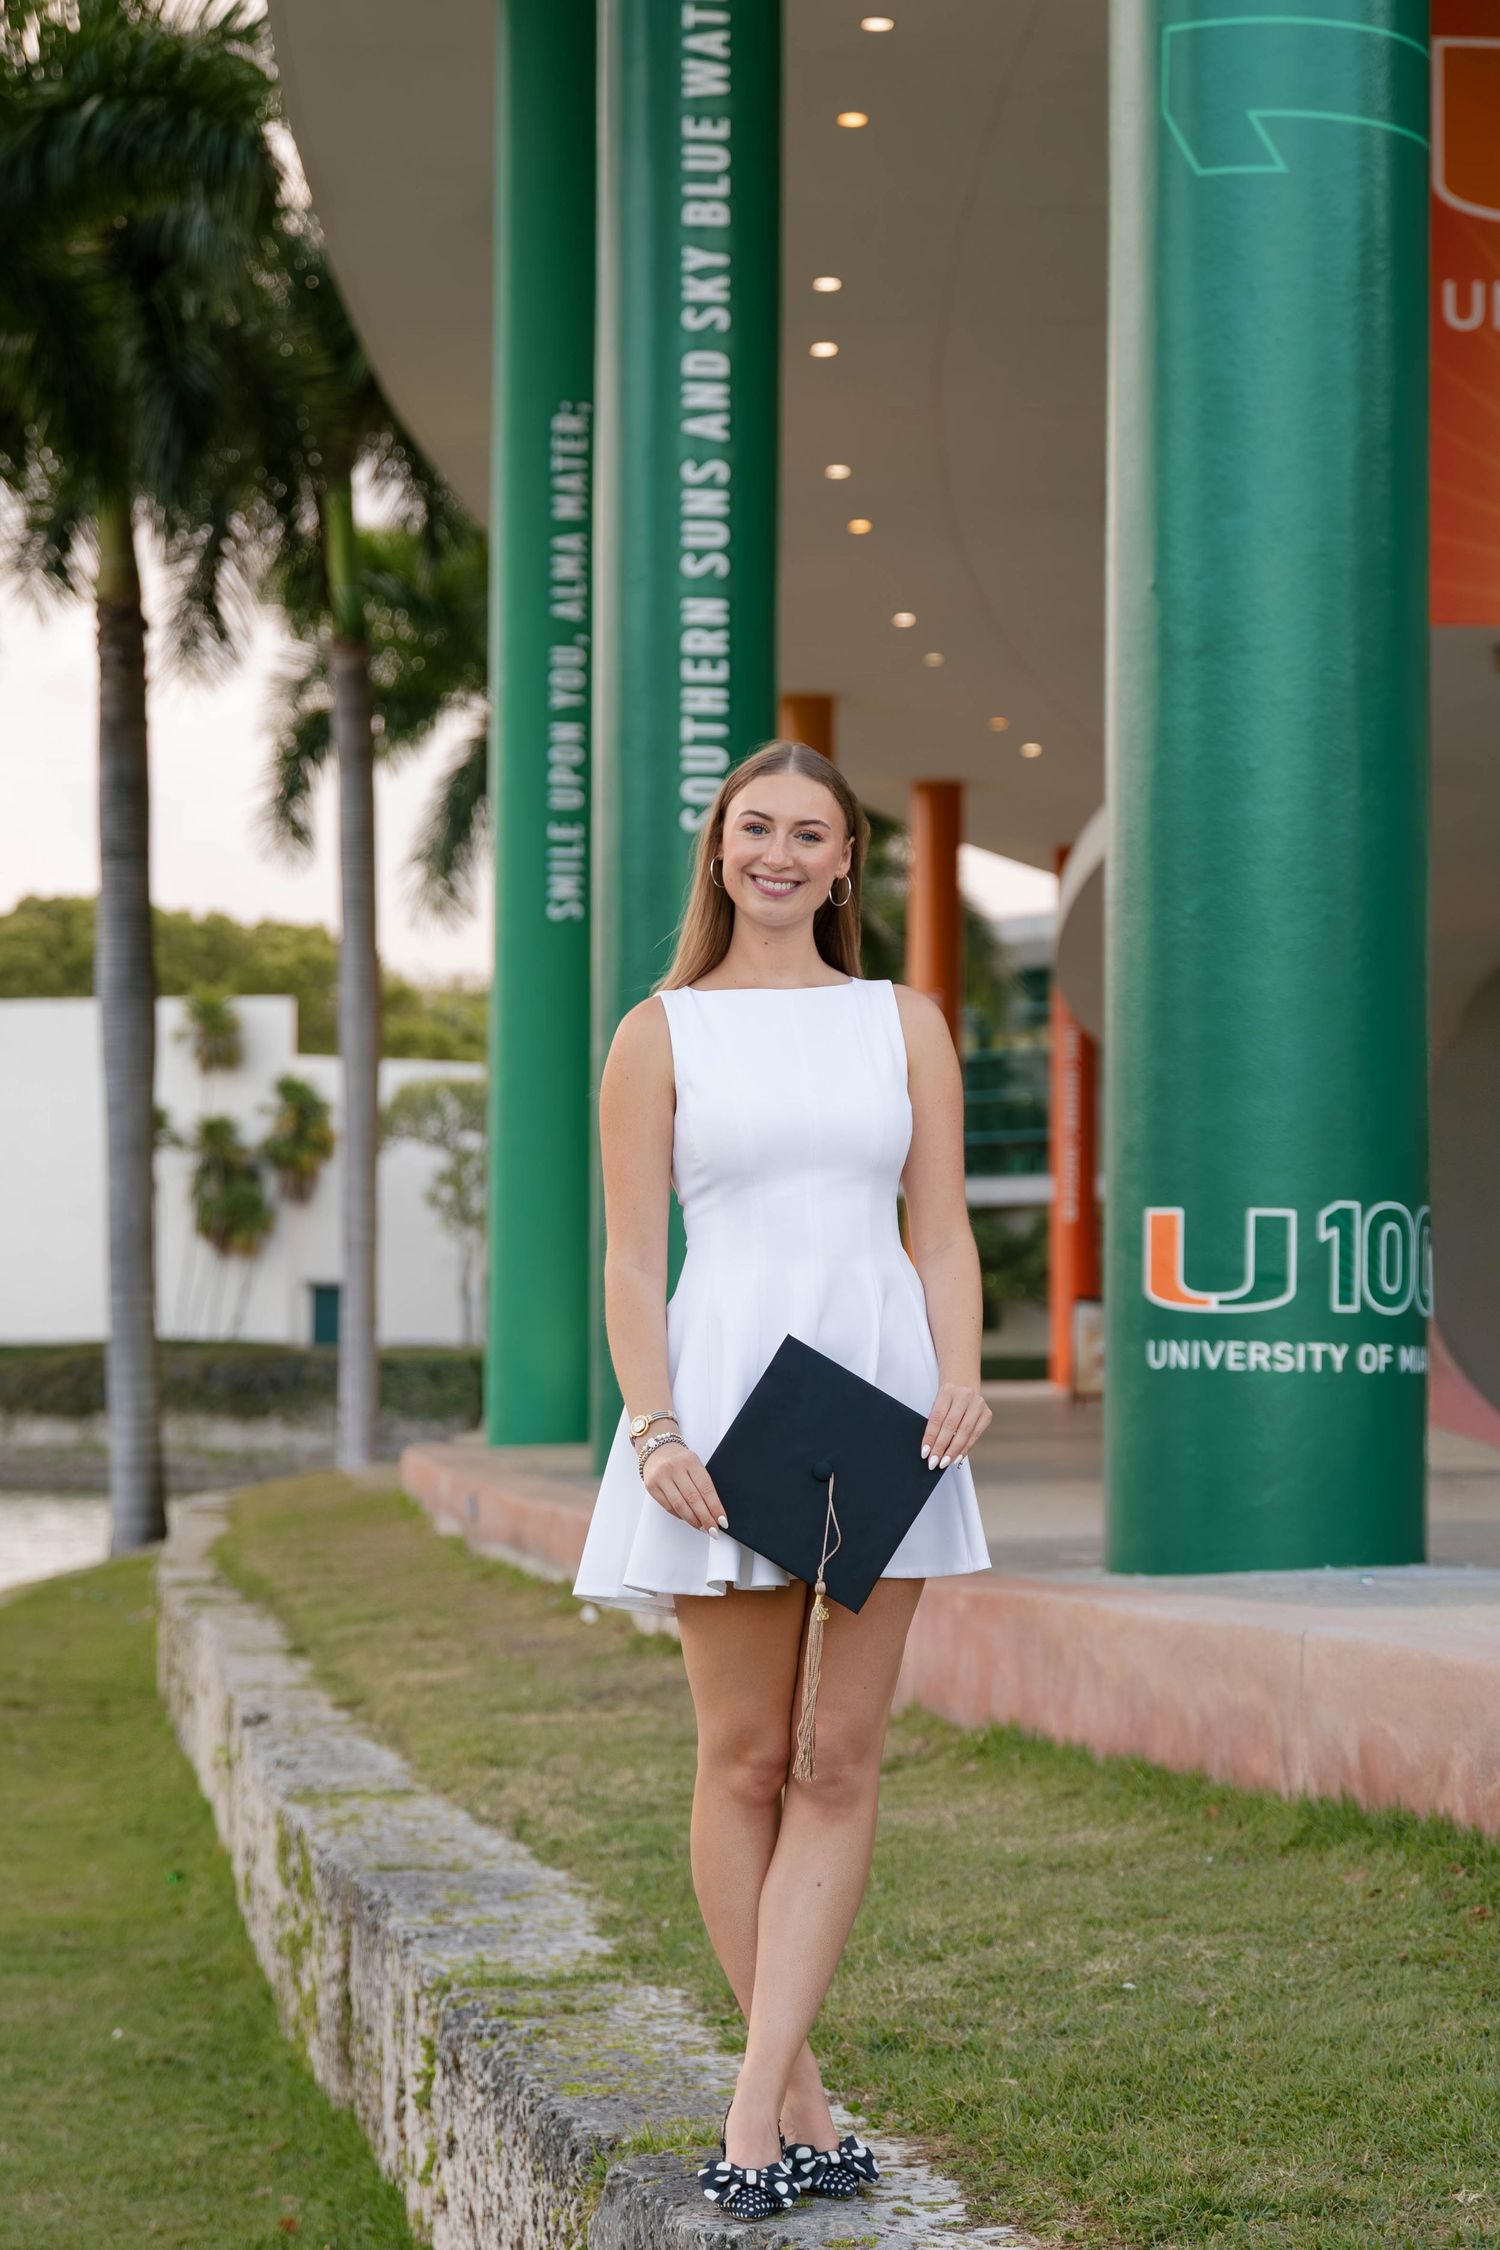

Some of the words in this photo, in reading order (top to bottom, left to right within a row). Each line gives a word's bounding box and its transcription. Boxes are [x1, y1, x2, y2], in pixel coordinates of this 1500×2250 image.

[680, 0, 731, 98] WAT
[680, 116, 731, 227] BLUE
[680, 245, 731, 333] SKY
[680, 349, 731, 442] AND
[680, 458, 731, 580] SUNS
[550, 531, 588, 623] ALMA
[548, 634, 590, 711] YOU,
[547, 721, 586, 812] UPON
[546, 822, 586, 923] SMILE
[1143, 1206, 1298, 1314] U
[1146, 1339, 1349, 1374] UNIVERSITY
[1355, 1343, 1394, 1374] OF
